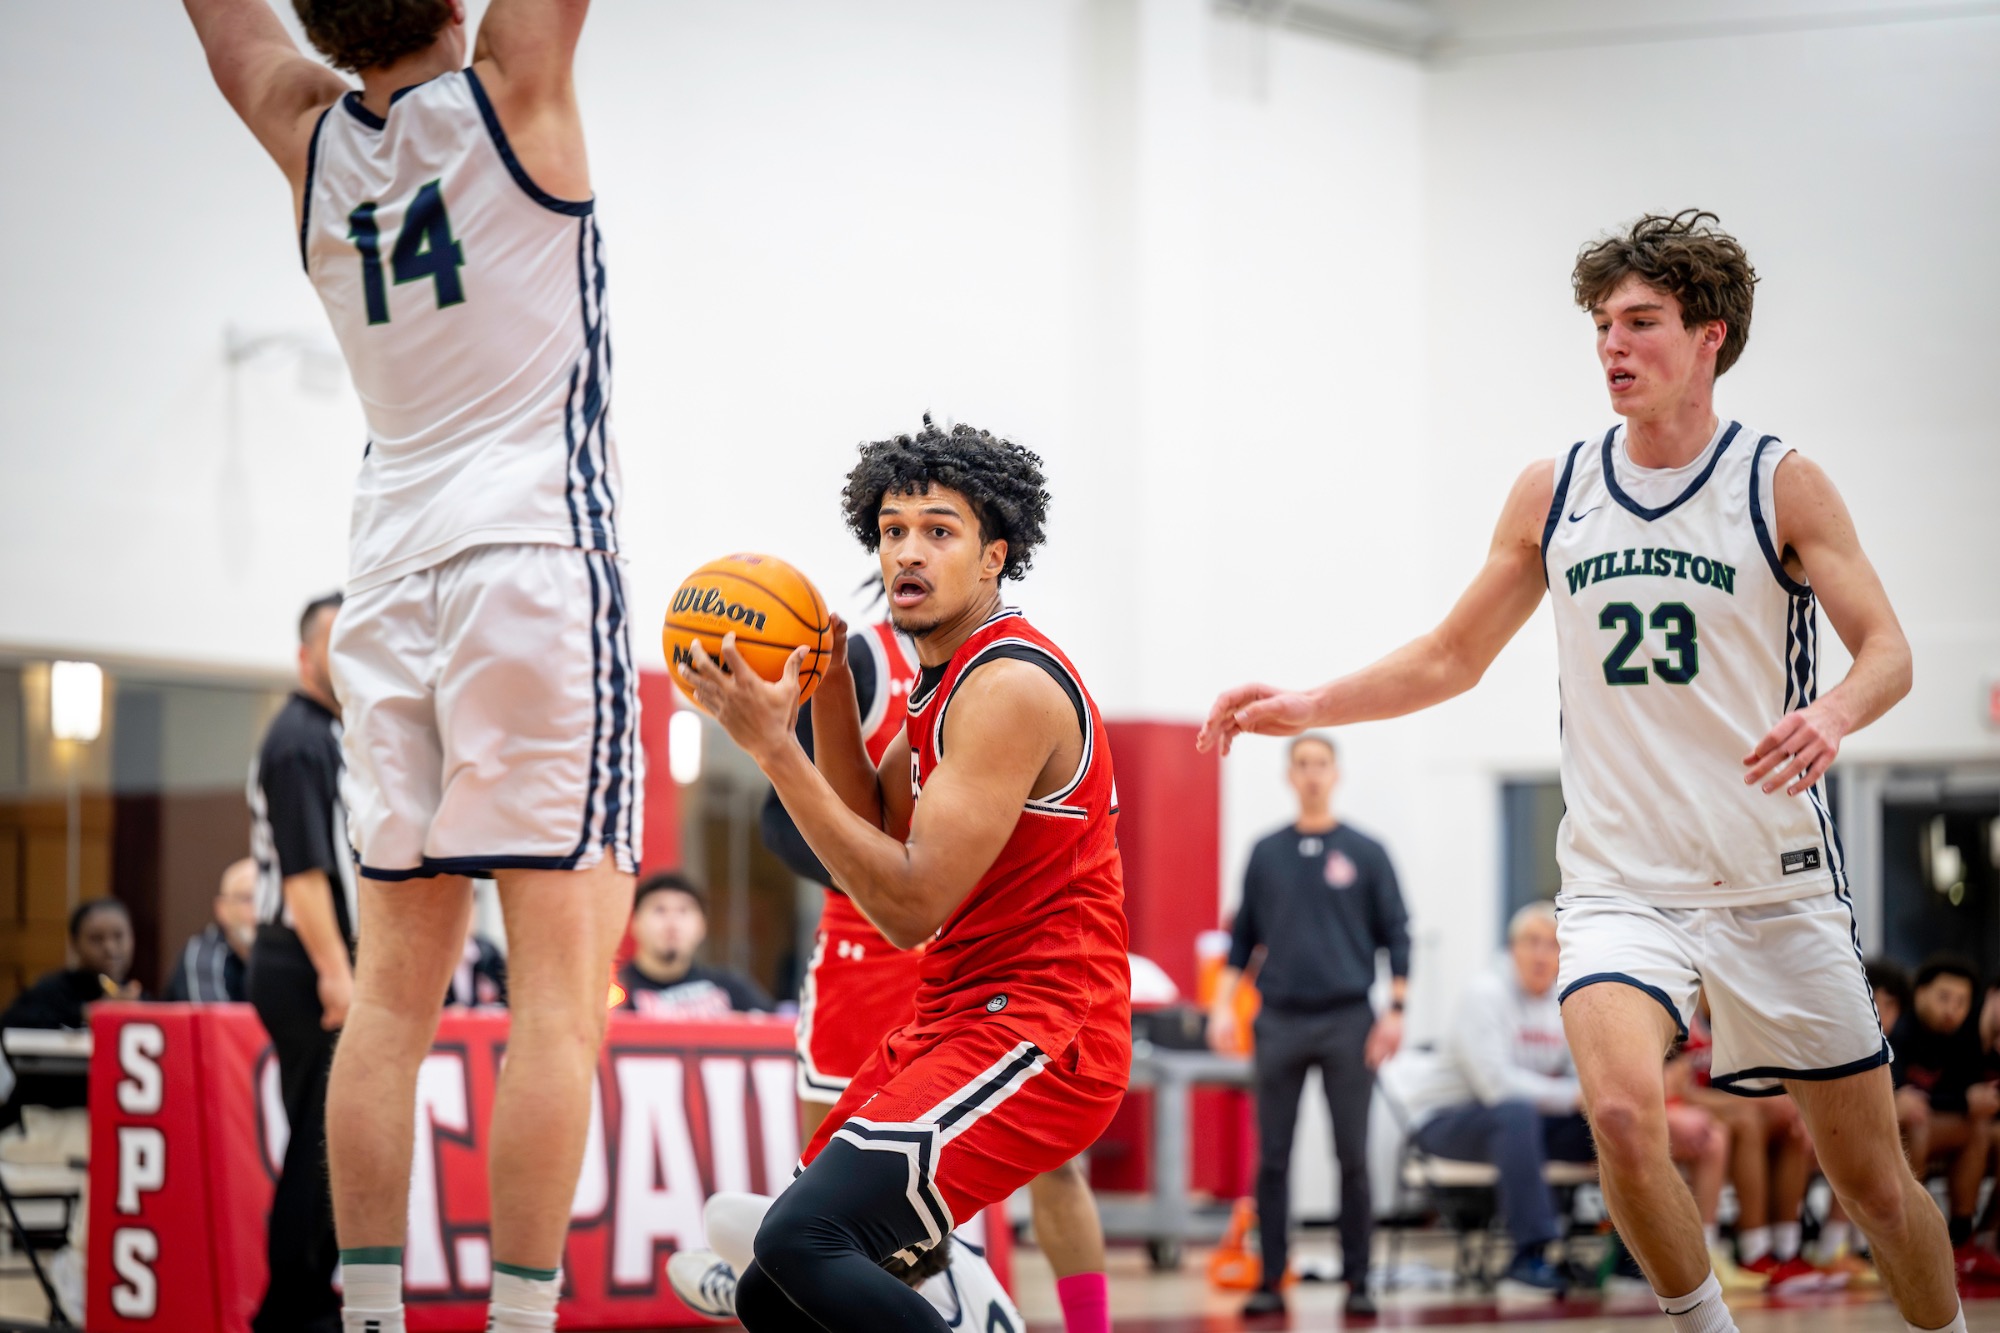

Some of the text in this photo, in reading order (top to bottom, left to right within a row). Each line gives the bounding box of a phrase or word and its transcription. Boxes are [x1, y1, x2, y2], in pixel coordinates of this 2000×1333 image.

[347, 177, 466, 326] 14
[1565, 547, 1736, 597] WILLISTON
[671, 586, 768, 633] Wilson
[1598, 602, 1699, 686] 23
[1806, 855, 1817, 865] XL
